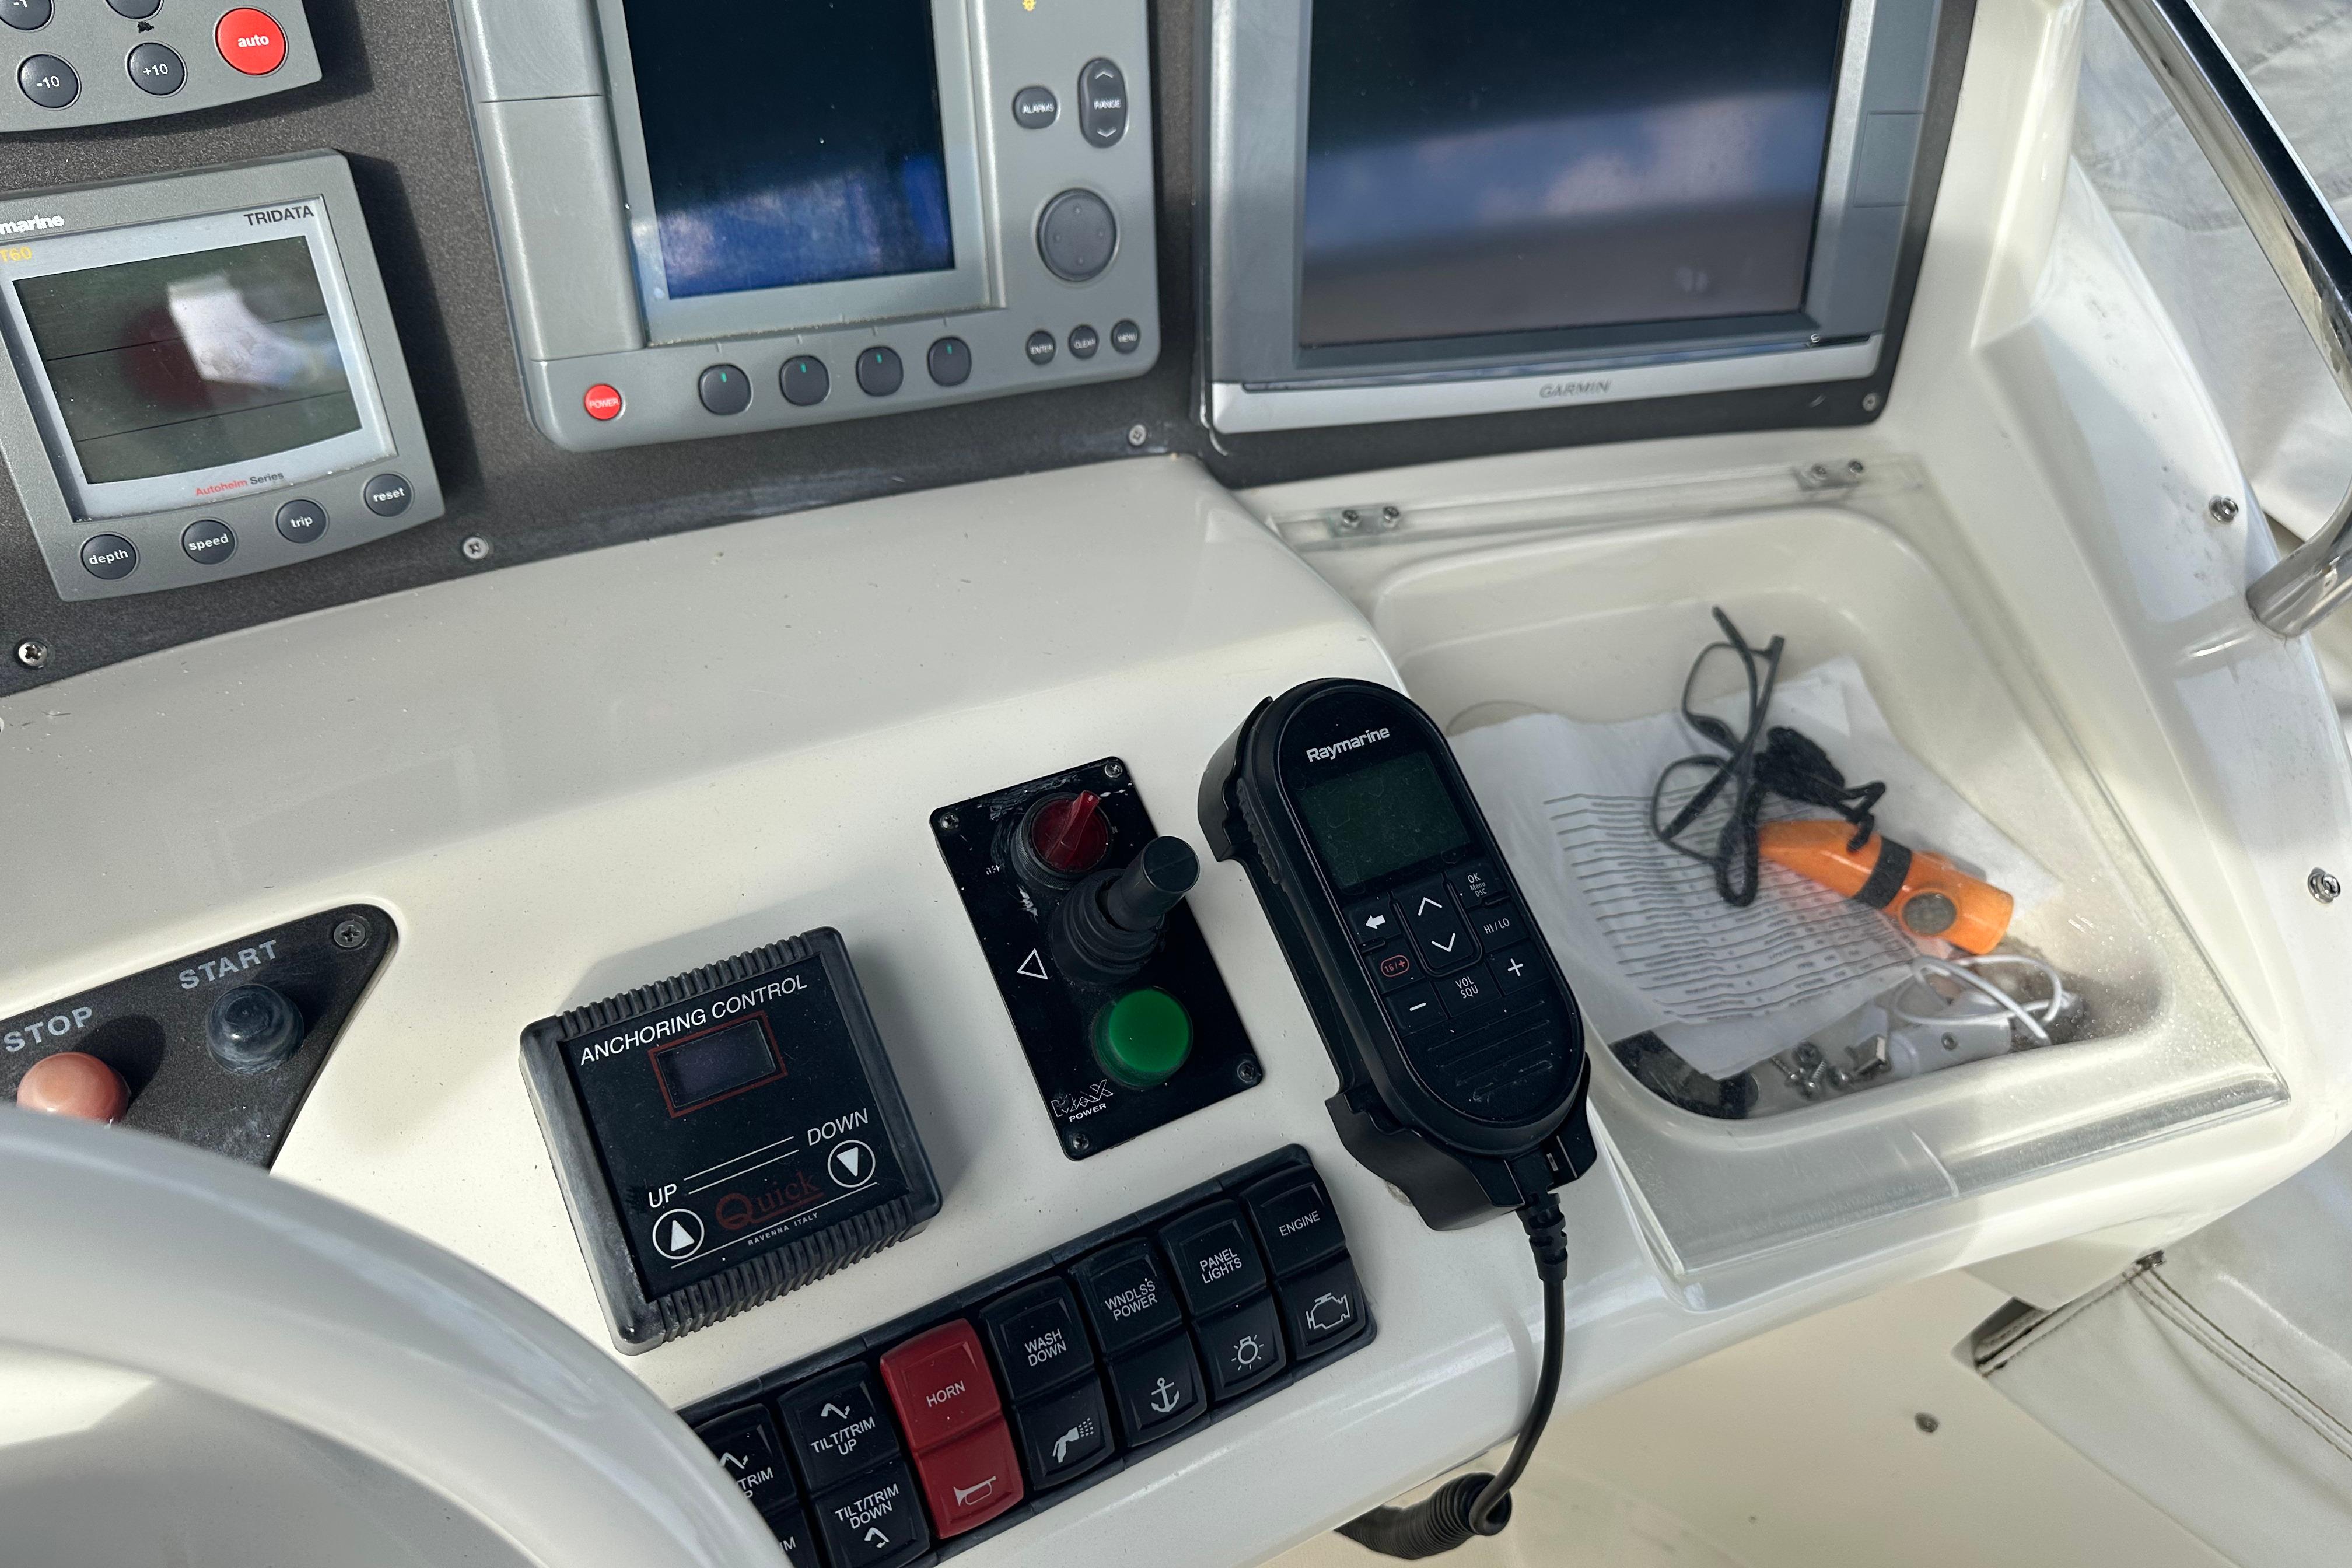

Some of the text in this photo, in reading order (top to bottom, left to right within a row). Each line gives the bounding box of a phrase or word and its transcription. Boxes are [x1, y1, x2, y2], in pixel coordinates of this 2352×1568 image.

[237, 33, 270, 48] auto
[142, 62, 169, 77] +10
[36, 75, 60, 89] -10
[243, 205, 314, 227] TRIDATA
[1539, 380, 1609, 398] GARMIN
[590, 398, 618, 409] POWER
[195, 471, 284, 497] Autohelm Series
[372, 486, 405, 503] reset
[290, 514, 313, 529] trip
[188, 533, 229, 551] speed
[89, 548, 129, 566] depth
[1306, 727, 1391, 763] Raymarine
[1467, 873, 1481, 884] OK
[1470, 881, 1486, 891] Menu
[1475, 888, 1488, 897] DSC
[179, 939, 277, 990] START
[1455, 976, 1474, 989] VOL
[1460, 985, 1479, 999] SQU
[3, 1006, 93, 1052] STOP
[580, 975, 808, 1066] ANCHORING CONTROL
[1069, 1103, 1107, 1122] POWER
[808, 1108, 869, 1146] DOWN
[648, 1184, 677, 1208] UP
[715, 1170, 824, 1230] Quick
[748, 1213, 818, 1246] RAVENNA ITALY
[1279, 1210, 1320, 1237] ENGINE
[1200, 1248, 1238, 1272] PANEL
[1202, 1258, 1242, 1283] LIGHTS
[1105, 1280, 1156, 1310] WNDLSS
[1113, 1293, 1157, 1321] POWER
[1025, 1328, 1062, 1353] WASH
[1028, 1342, 1067, 1367] DOWN
[926, 1380, 965, 1408] HORN
[811, 1416, 876, 1454] TILT/TRIM
[839, 1438, 858, 1455] UP
[835, 1483, 900, 1521] TILT/TRIM
[850, 1500, 892, 1529] DOWN
